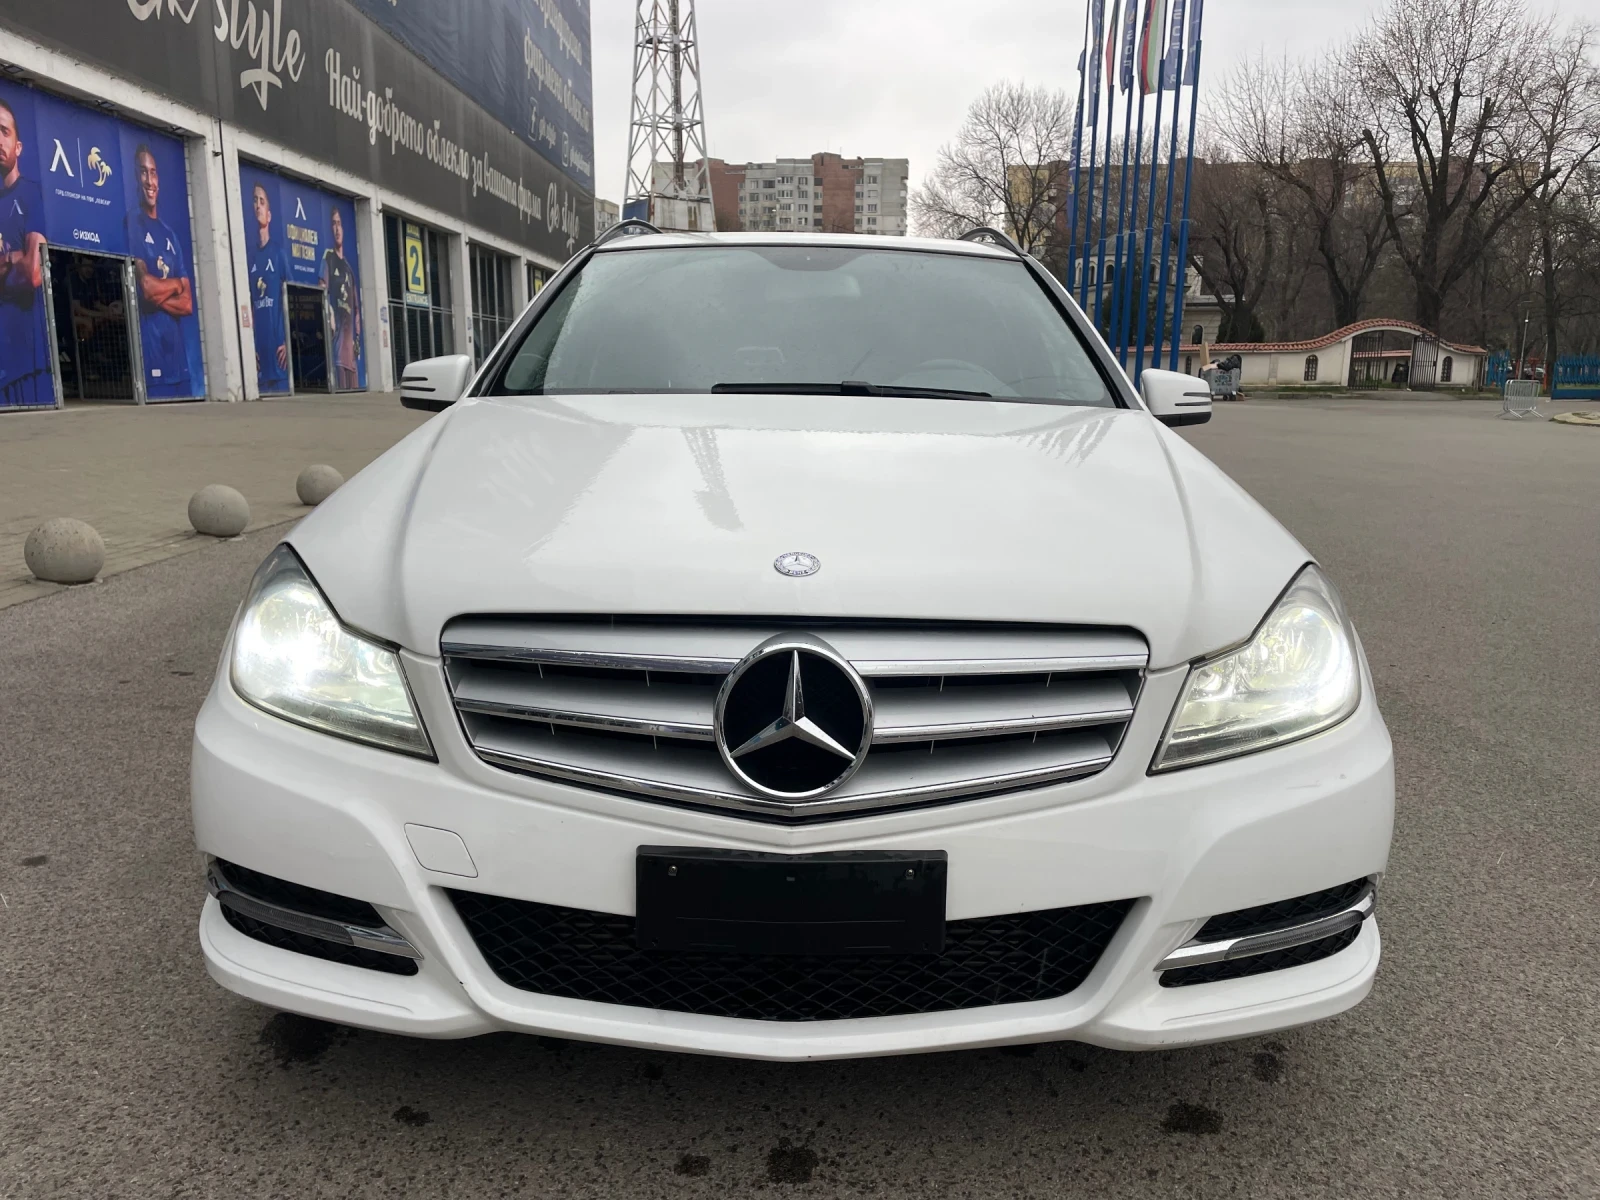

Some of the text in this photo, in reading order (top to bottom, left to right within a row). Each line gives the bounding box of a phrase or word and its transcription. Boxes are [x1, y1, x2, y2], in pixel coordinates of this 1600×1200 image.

[325, 48, 424, 155] Най-доброто
[427, 119, 469, 180] облекло
[471, 156, 483, 198] за
[484, 151, 517, 212] вашата
[518, 177, 541, 225] фирма
[561, 190, 580, 256] style
[80, 229, 101, 243] ИЗХОД
[410, 245, 421, 286] 2
